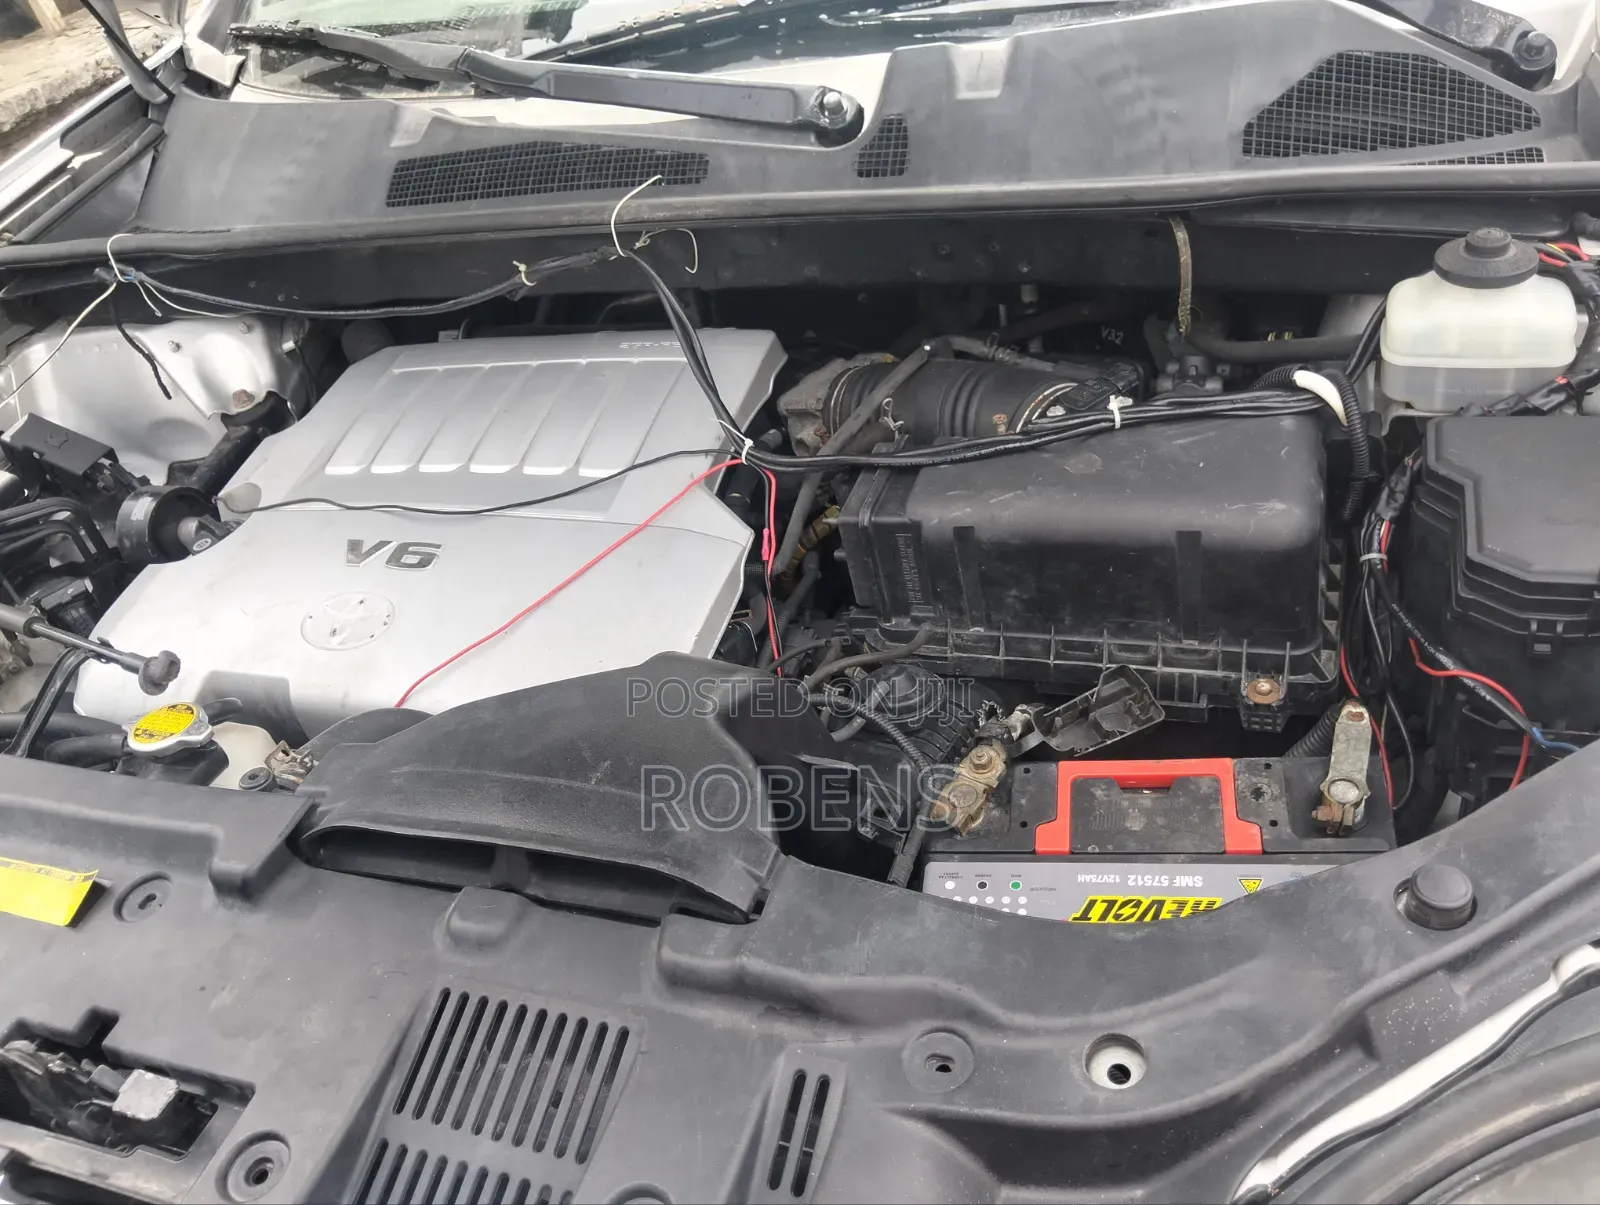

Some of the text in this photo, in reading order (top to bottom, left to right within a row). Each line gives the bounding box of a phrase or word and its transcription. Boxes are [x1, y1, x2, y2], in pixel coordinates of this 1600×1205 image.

[1101, 324, 1125, 347] V32
[345, 538, 444, 571] V6
[1077, 874, 1204, 888] SMF 57512 12V75AH
